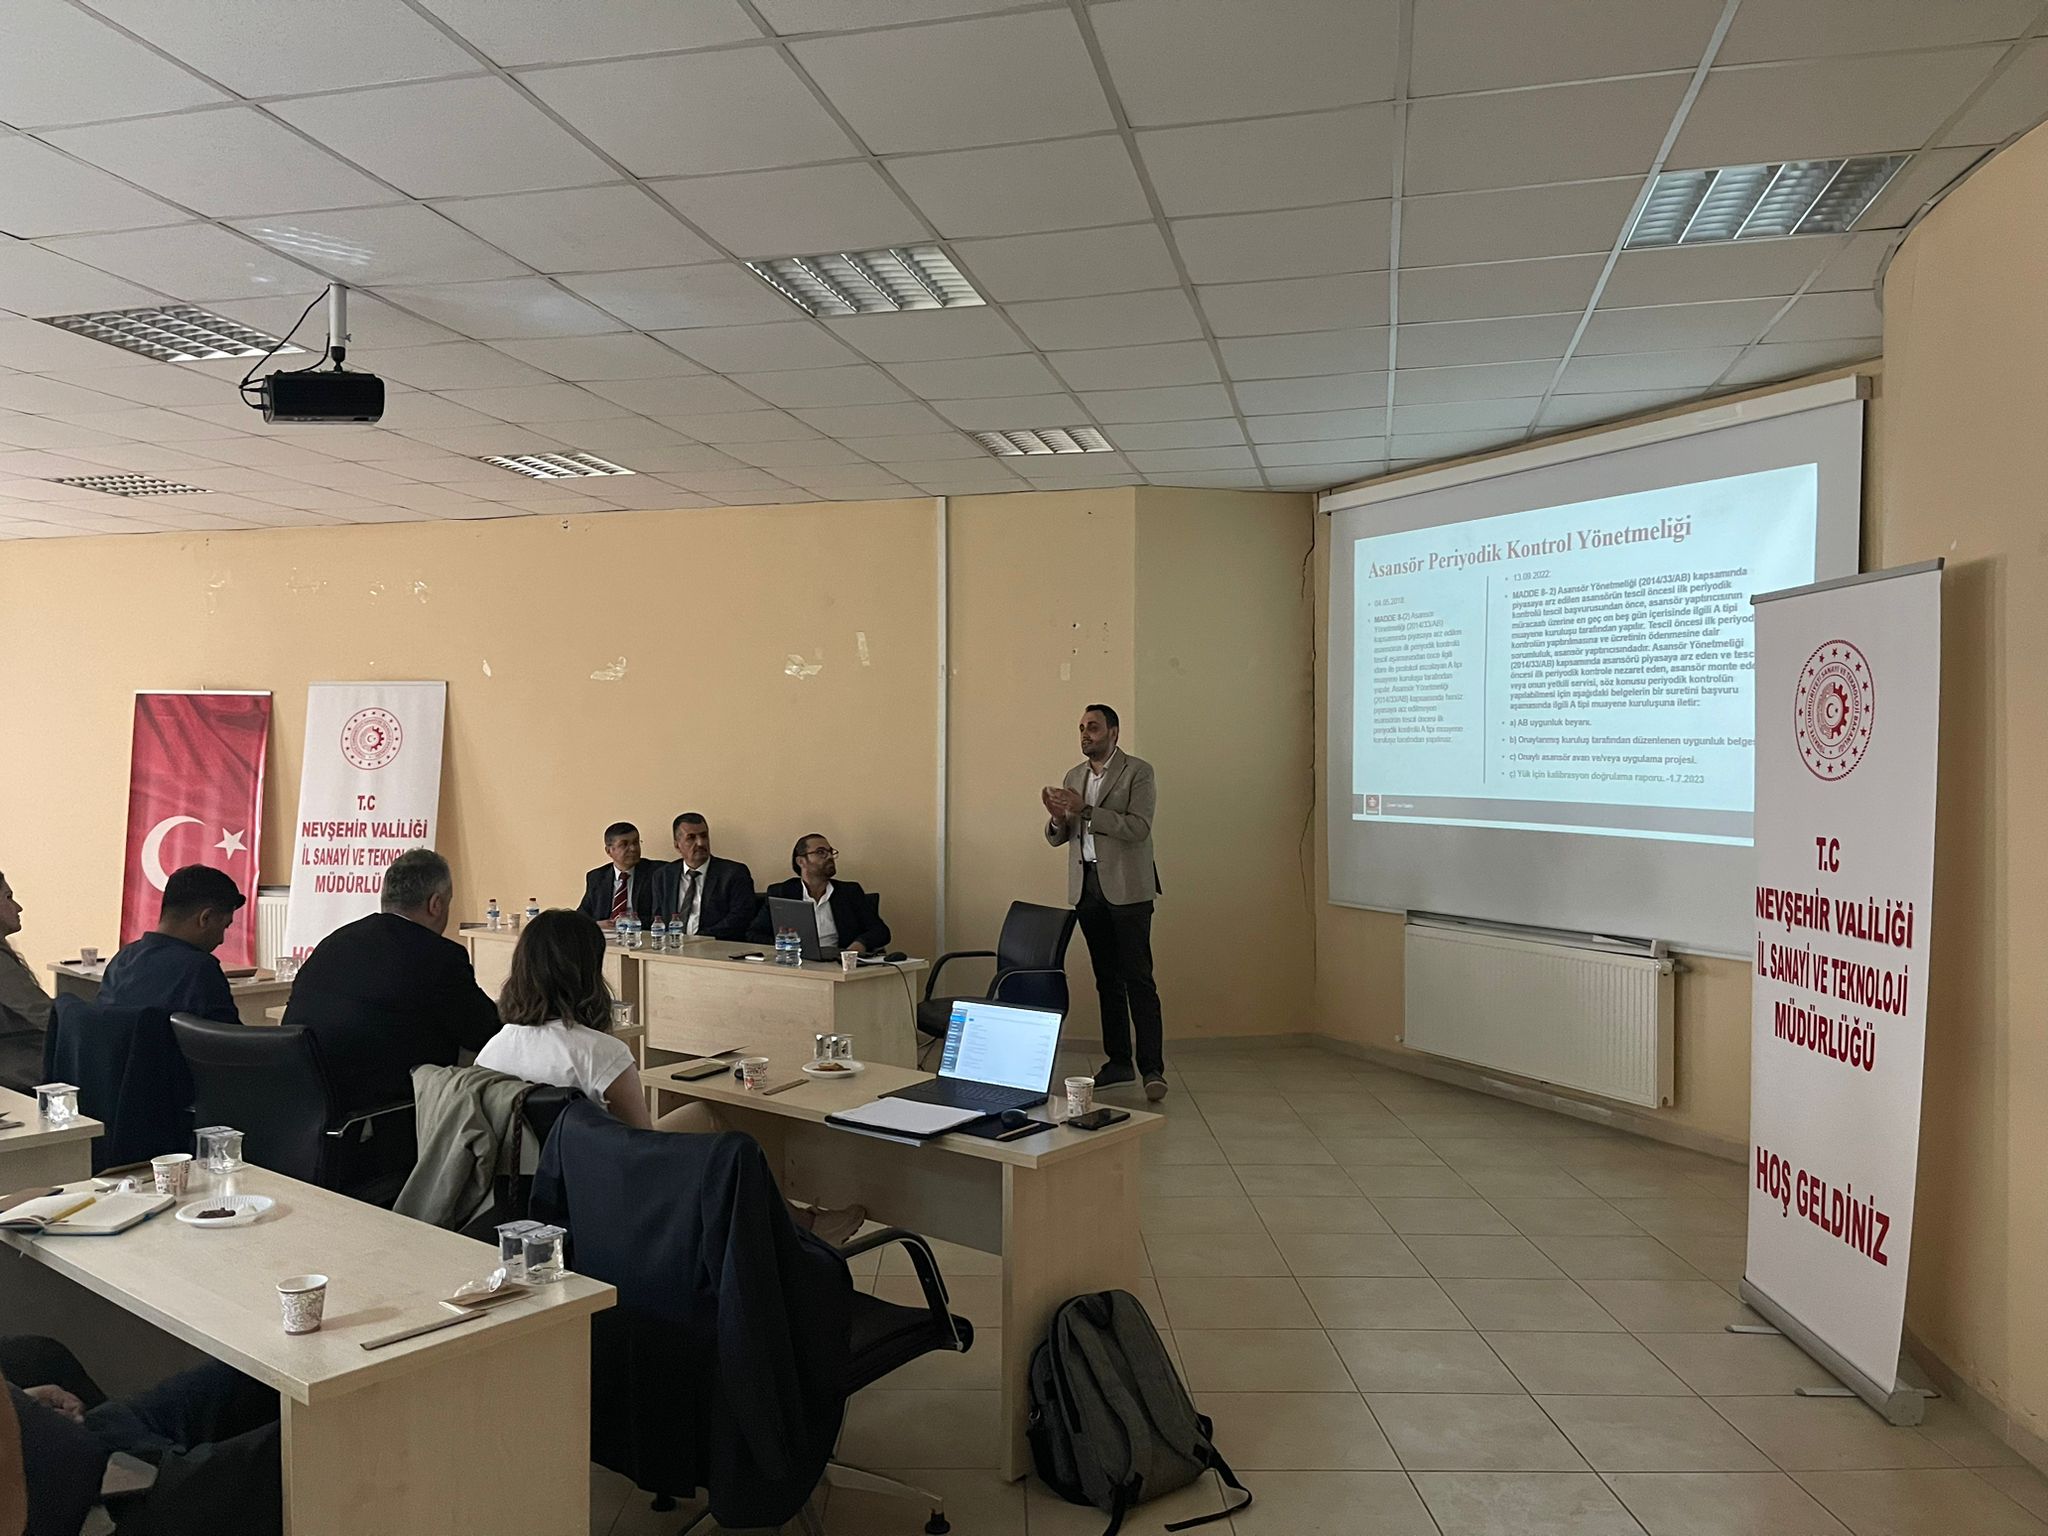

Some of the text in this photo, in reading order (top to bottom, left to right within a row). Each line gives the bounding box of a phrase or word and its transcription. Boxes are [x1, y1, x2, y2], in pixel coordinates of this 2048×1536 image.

[1368, 514, 1692, 580] Asansör Periyodik Kontrol Yönetmeliği
[1513, 589, 1539, 598] MADDE
[1558, 584, 1588, 594] Asansör
[1591, 579, 1636, 591] Yönetmeliği
[1639, 573, 1691, 587] (2014/33/AB)
[1693, 568, 1747, 580] kapsamında
[1512, 592, 1742, 618] kontrolü tescil başvurusundan önce, asansör yaptırıcısının
[1513, 600, 1542, 610] piyasaya
[1557, 596, 1580, 604] edilen
[1582, 592, 1622, 602] asansörün
[1625, 589, 1645, 598] tescil
[1648, 586, 1675, 595] öncesi
[1690, 581, 1731, 593] periyodik
[1548, 617, 1574, 626] üzerine
[1588, 615, 1600, 625] geç
[1615, 612, 1630, 621] beş
[1631, 611, 1647, 621] gün
[1649, 607, 1690, 619] içerisinde
[1693, 605, 1711, 615] ilgili
[1723, 603, 1738, 614] tipi
[1545, 627, 1577, 637] kuruluşu
[1579, 623, 1616, 633] tarafından
[1619, 622, 1645, 632] yapılır.
[1648, 620, 1671, 628] Tescil
[1674, 618, 1702, 627] öncesi
[1705, 616, 1716, 624] ilk
[1718, 614, 1754, 625] periyod
[1511, 640, 1545, 648] kontrolün
[1611, 631, 1646, 642] ücretinin
[1649, 630, 1700, 639] ödenmesine
[1702, 628, 1720, 636] dair
[1554, 648, 1583, 656] asansör
[1652, 643, 1687, 651] Asansör
[1689, 638, 1744, 649] Yönetmeliği
[1511, 660, 1554, 670] (2014/33/AB)
[1556, 657, 1600, 667] kapsamında
[1603, 655, 1639, 663] asansörü
[1641, 652, 1677, 664] piyasaya
[1734, 650, 1755, 658] tesc
[1545, 669, 1578, 679] periyodik
[1581, 668, 1612, 676] kontrole
[1614, 666, 1644, 674] nezaret
[1646, 665, 1668, 674] eden,
[1671, 663, 1705, 672] asansör
[1708, 662, 1737, 670] monte
[1548, 680, 1569, 689] yetkili
[1616, 676, 1646, 686] konusu
[1648, 675, 1686, 686] periyodik
[1689, 674, 1733, 682] kontrolün
[1557, 690, 1570, 698] için
[1611, 687, 1650, 697] belgelerin
[1652, 686, 1663, 695] bir
[1666, 686, 1698, 695] suretini
[1701, 686, 1738, 696] başvuru
[1840, 667, 1846, 675] VE
[1846, 672, 1859, 713] TEKNOLOJİ
[1553, 701, 1568, 710] ilgili
[1591, 700, 1626, 709] muayene
[1629, 699, 1675, 708] kuruluşuna
[1530, 719, 1563, 728] uygunluk
[1510, 736, 1516, 744] b)
[1562, 736, 1589, 744] kuruluş
[1633, 736, 1680, 744] düzenlenen
[1683, 737, 1724, 746] uygunluk
[1510, 754, 1516, 762] c)
[1592, 754, 1620, 763] ve/veya
[1622, 755, 1662, 764] uygulama
[1665, 756, 1696, 765] projesi.
[1532, 770, 1545, 779] için
[1591, 772, 1632, 781] doğrulama
[357, 795, 376, 810] T.C
[302, 819, 428, 841] NEVŞEHİR VALİLİĞİ
[302, 844, 310, 865] İL
[313, 844, 350, 865] SANAYİ
[353, 848, 364, 865] VE
[1816, 836, 1840, 873] T.C
[315, 872, 381, 893] MÜDÜRLÜ
[1755, 886, 1914, 949] NEVŞEHİR VALİLİĞİ
[1757, 931, 1909, 1017] İL SANAYİ VE TEKNOLOJİ
[1774, 997, 1876, 1072] MÜDÜRLÜĞÜ
[1756, 1145, 1891, 1267] HOŞ GELDİNİZ
